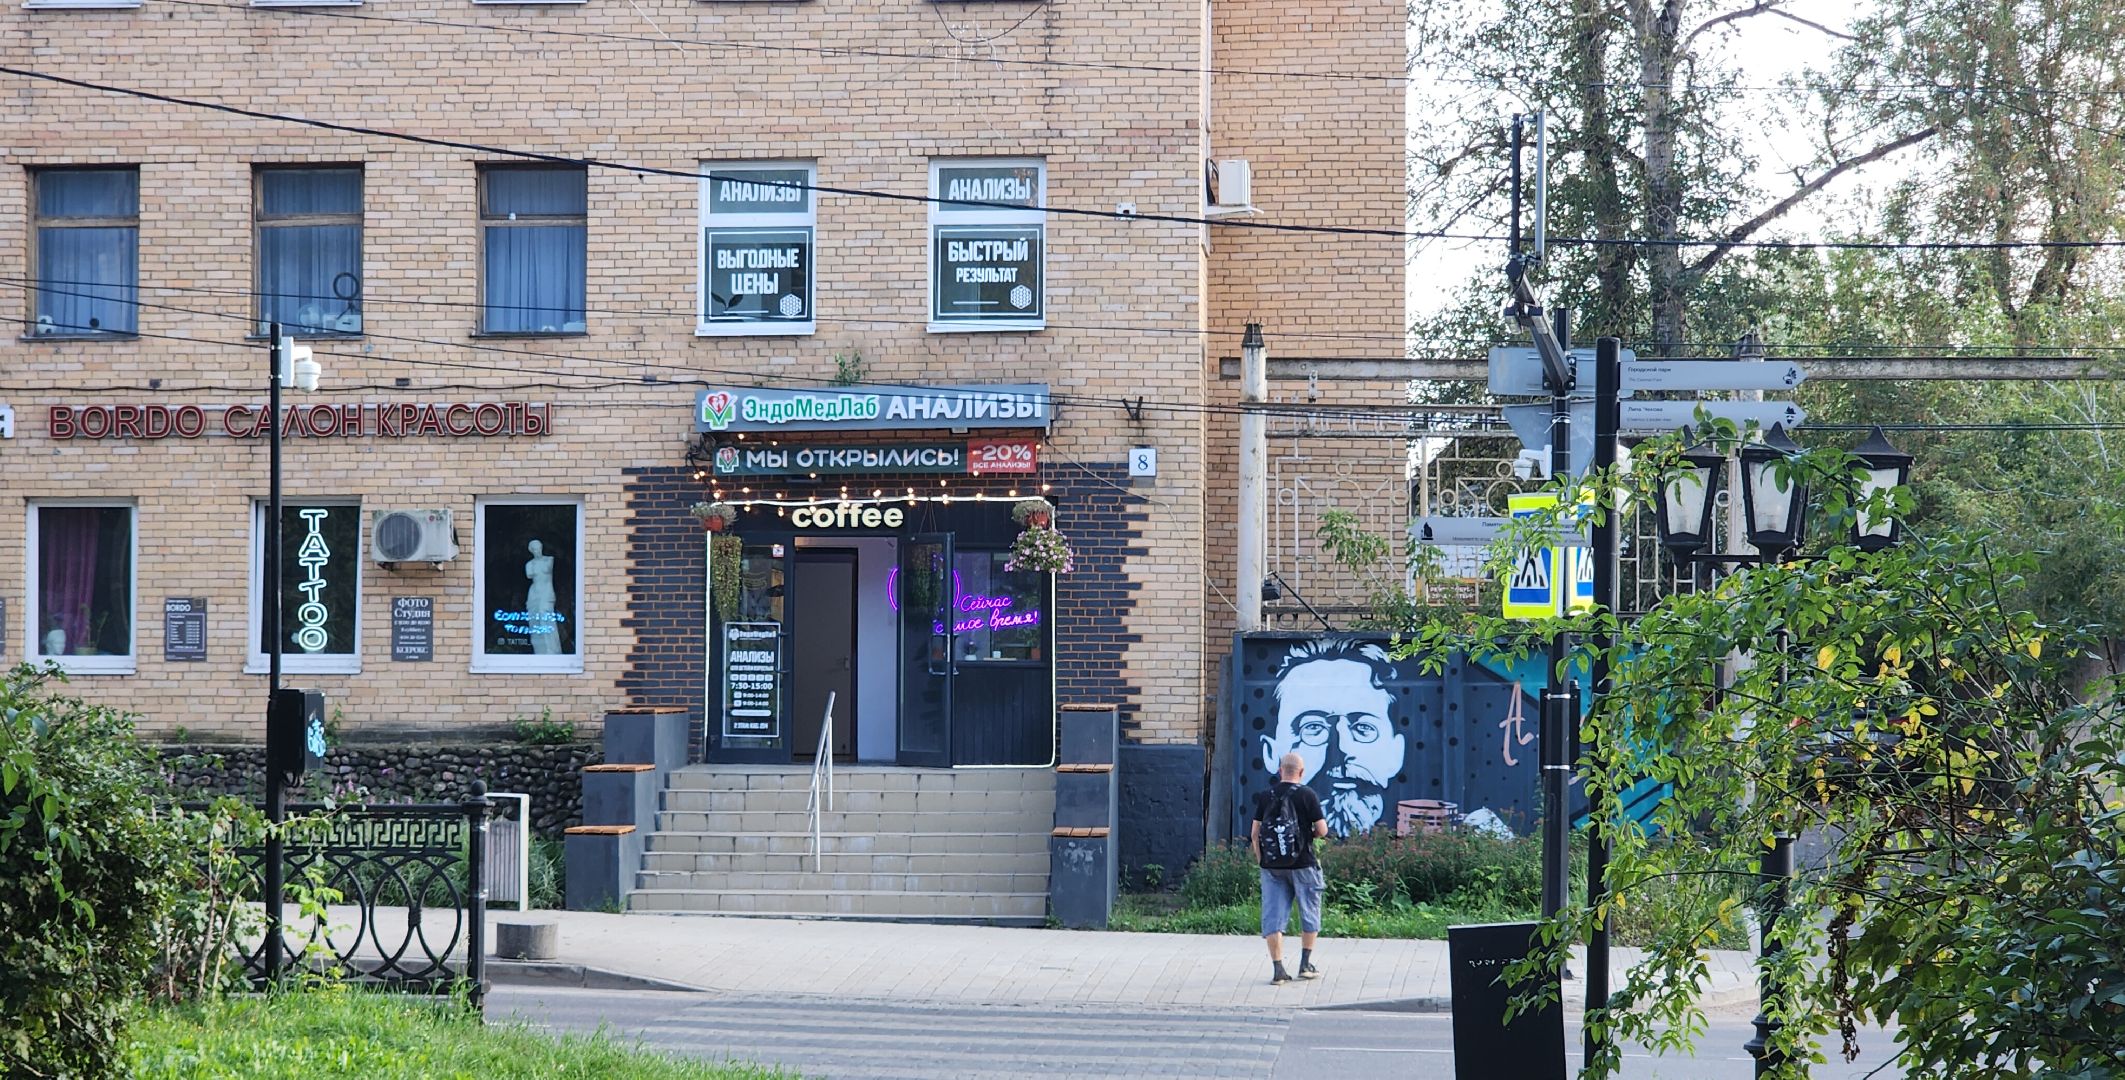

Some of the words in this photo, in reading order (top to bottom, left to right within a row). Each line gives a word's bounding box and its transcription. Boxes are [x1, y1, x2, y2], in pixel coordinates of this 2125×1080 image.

[720, 180, 801, 202] АНАЛИЗЫ
[949, 177, 1031, 201] АНАЛИЗЫ
[717, 248, 800, 269] ВЫГОДНЫЕ
[948, 238, 1029, 262] БЫСТРЫЙ
[731, 272, 779, 295] ЦЕНЫ
[956, 267, 1018, 283] РЕЗУЛЬТАТ
[744, 395, 877, 422] ЭндоМедЛаб
[886, 394, 1042, 419] АНАЛИЗЫ
[49, 405, 206, 439] BORDO
[223, 404, 364, 438] САЛОН
[375, 402, 553, 437] КРАСОТЫ
[746, 450, 787, 468] МЫ
[796, 448, 959, 468] ОТКРЫЛИСЬ!
[972, 444, 1032, 460] -20%
[1138, 454, 1148, 470] 8
[792, 502, 904, 529] coffee
[298, 508, 331, 651] TATTOO
[394, 607, 430, 619] Студия
[398, 597, 428, 608] ФОТО
[960, 594, 1012, 612] Сейчас
[935, 618, 985, 634] смое
[990, 609, 1038, 632] время!
[730, 650, 775, 663] АНАЛИЗЫ
[730, 682, 774, 690] 7:30-15:00
